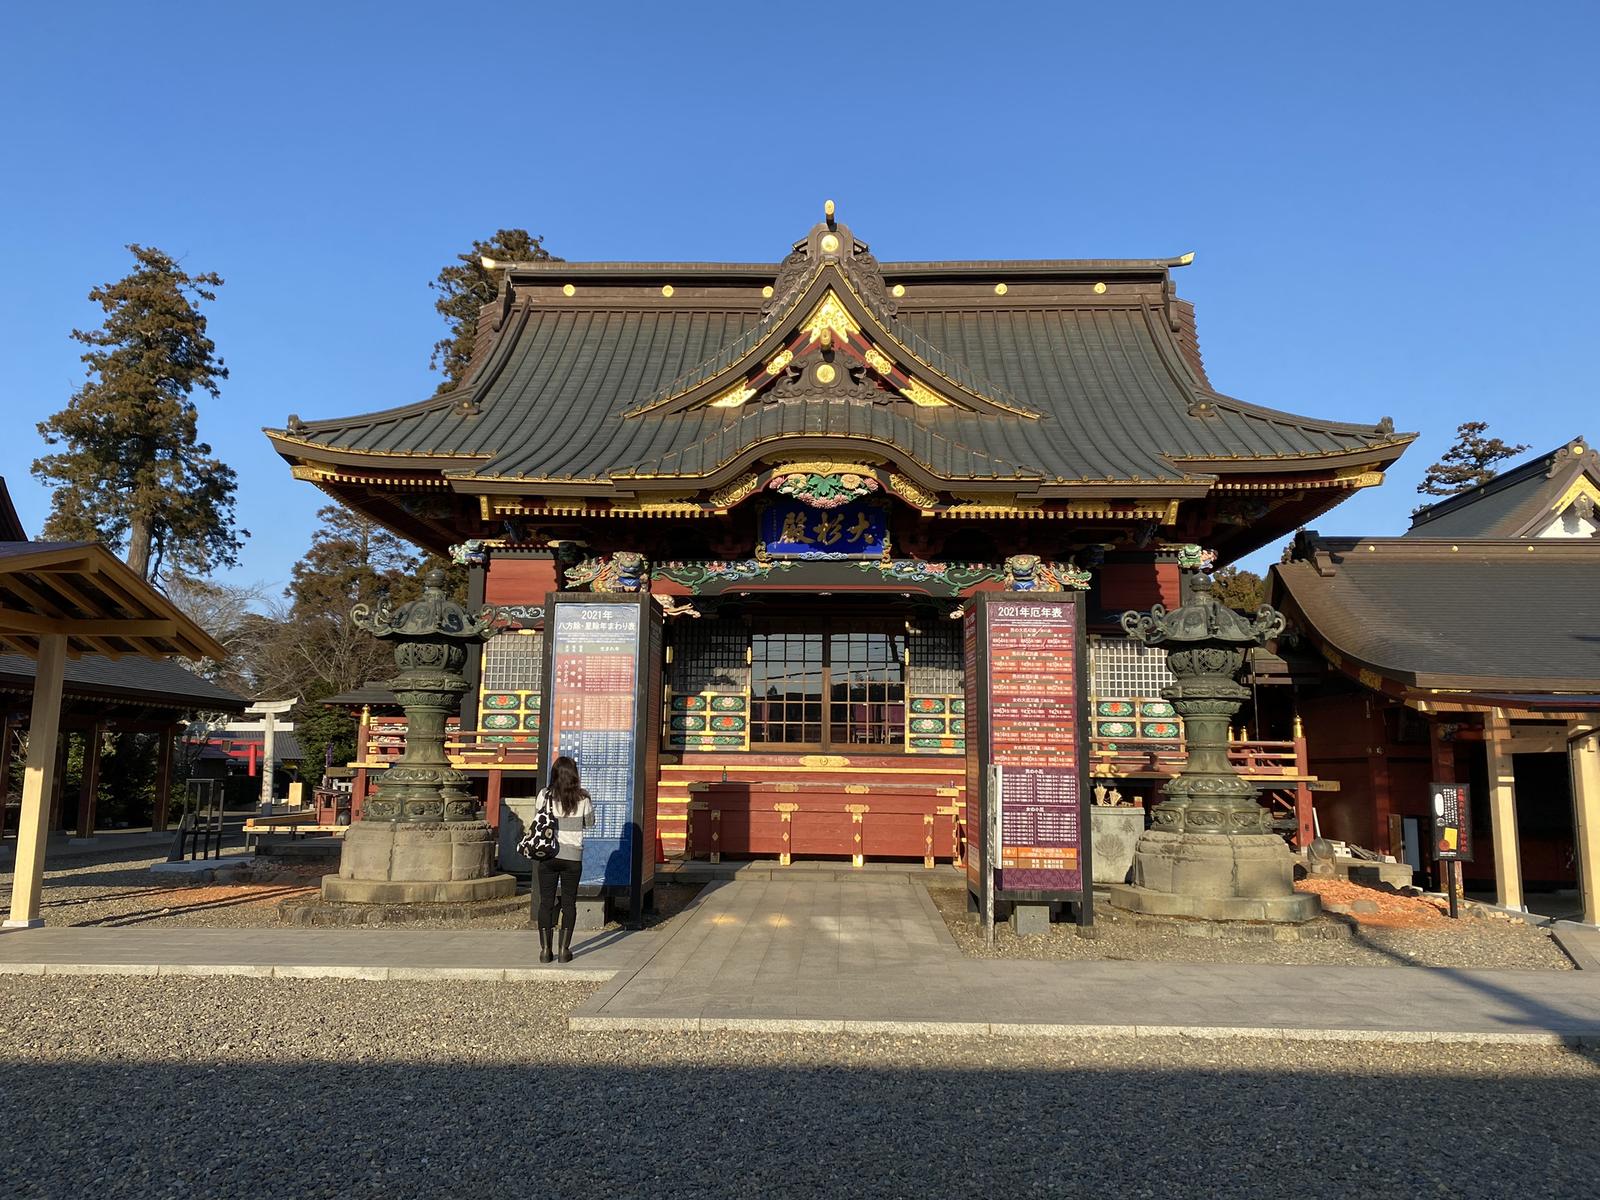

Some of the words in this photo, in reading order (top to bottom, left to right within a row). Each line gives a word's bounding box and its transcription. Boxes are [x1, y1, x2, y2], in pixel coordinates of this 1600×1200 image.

[581, 610, 613, 620] 2021年
[998, 607, 1062, 618] 2021年厄年表
